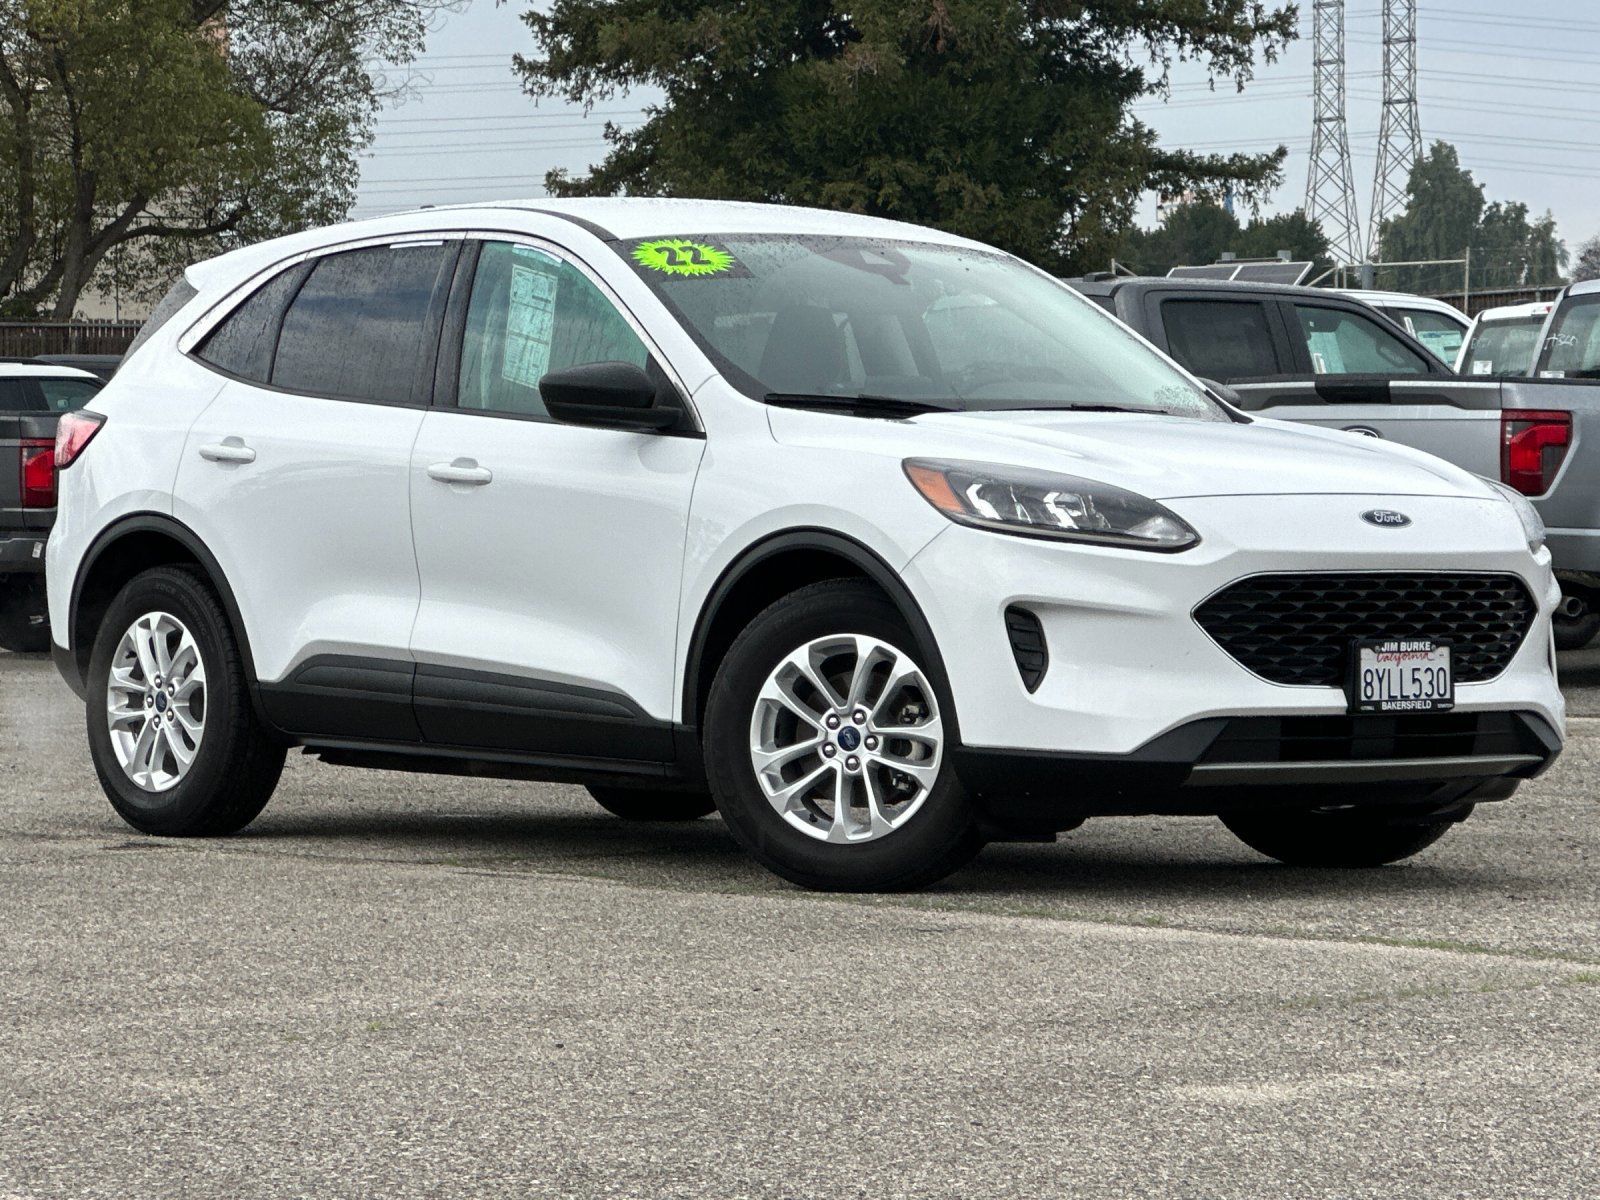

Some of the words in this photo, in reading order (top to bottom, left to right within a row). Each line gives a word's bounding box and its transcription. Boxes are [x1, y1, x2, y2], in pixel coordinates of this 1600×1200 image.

[654, 246, 712, 266] 22
[1373, 511, 1403, 523] Ford
[1381, 642, 1399, 652] JIM
[1400, 641, 1432, 652] BURKE
[1363, 667, 1448, 700] 8YLL530
[1381, 700, 1432, 711] BAKERSFIELD
